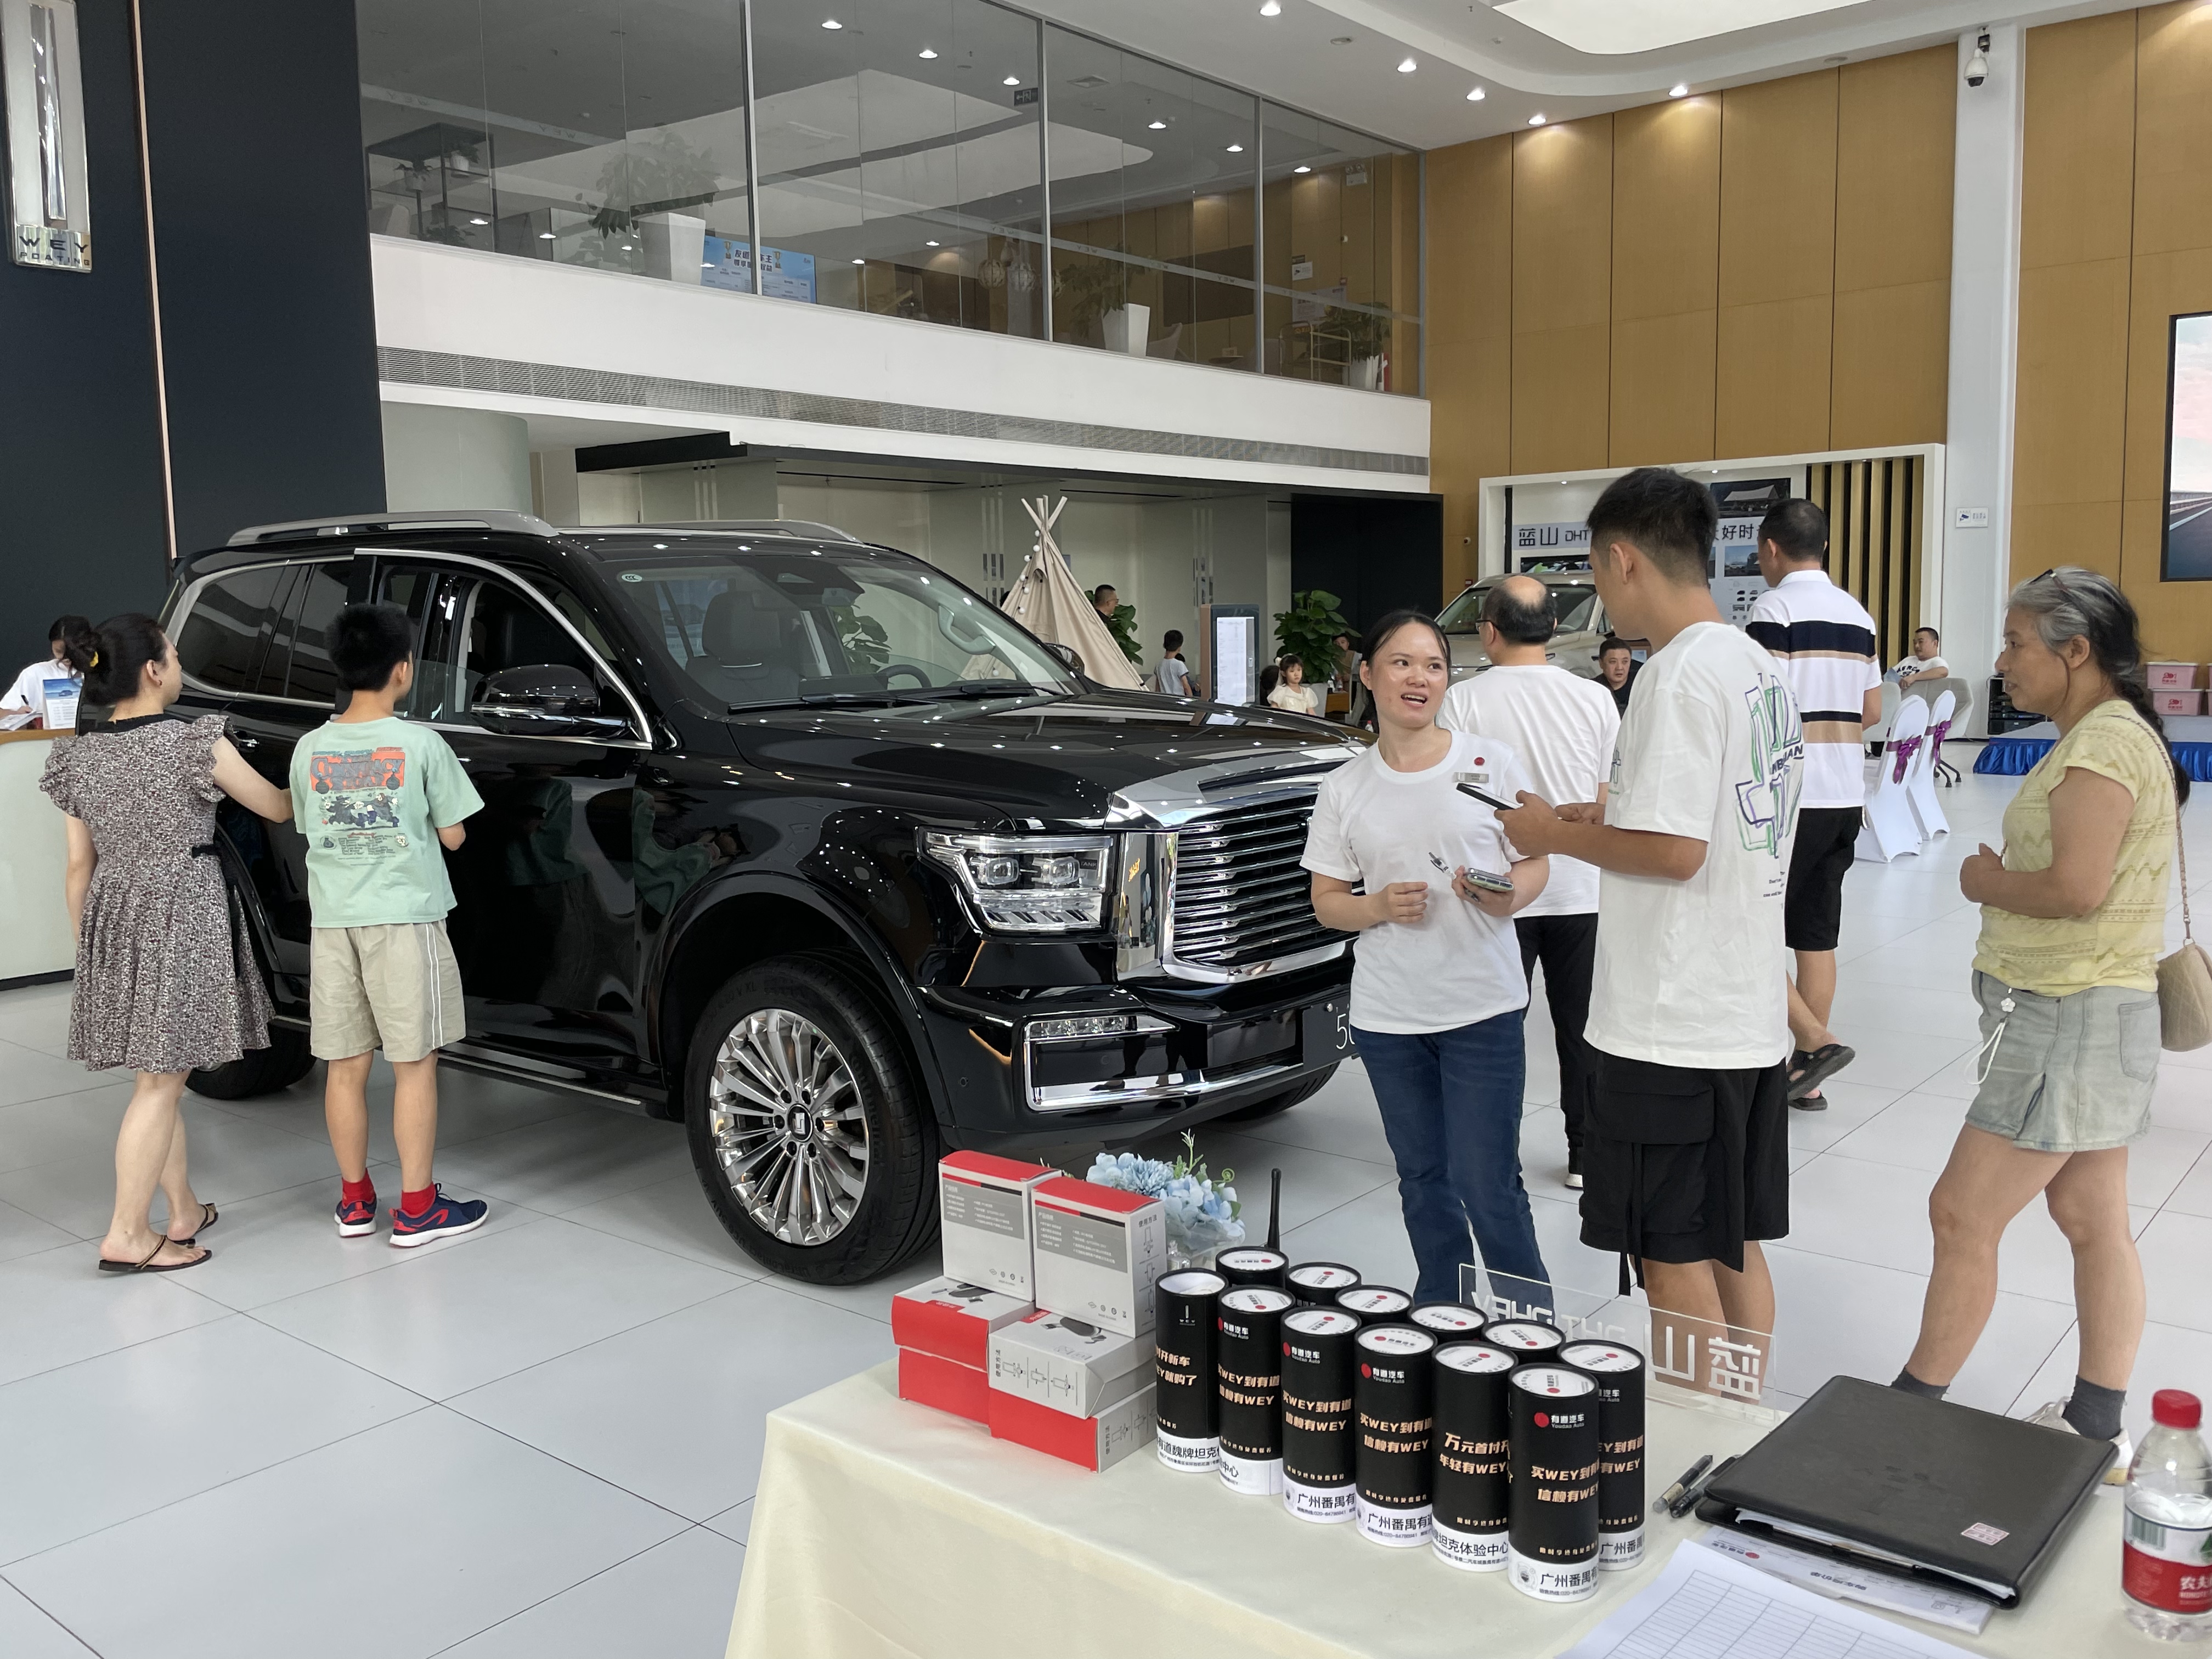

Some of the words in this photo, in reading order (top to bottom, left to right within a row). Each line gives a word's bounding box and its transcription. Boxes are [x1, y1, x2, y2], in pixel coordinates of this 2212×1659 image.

[20, 236, 88, 253] WEY
[1518, 527, 1559, 546] 蓝山
[1291, 1346, 1321, 1359] 有道汽车
[1372, 1367, 1405, 1379] 有道汽车
[1285, 1411, 1347, 1432] 信赖有WEY
[1551, 1413, 1585, 1424] 有道汽车
[1157, 1437, 1219, 1459] 有道魏牌坦克
[1364, 1434, 1429, 1454] 信赖有WEY
